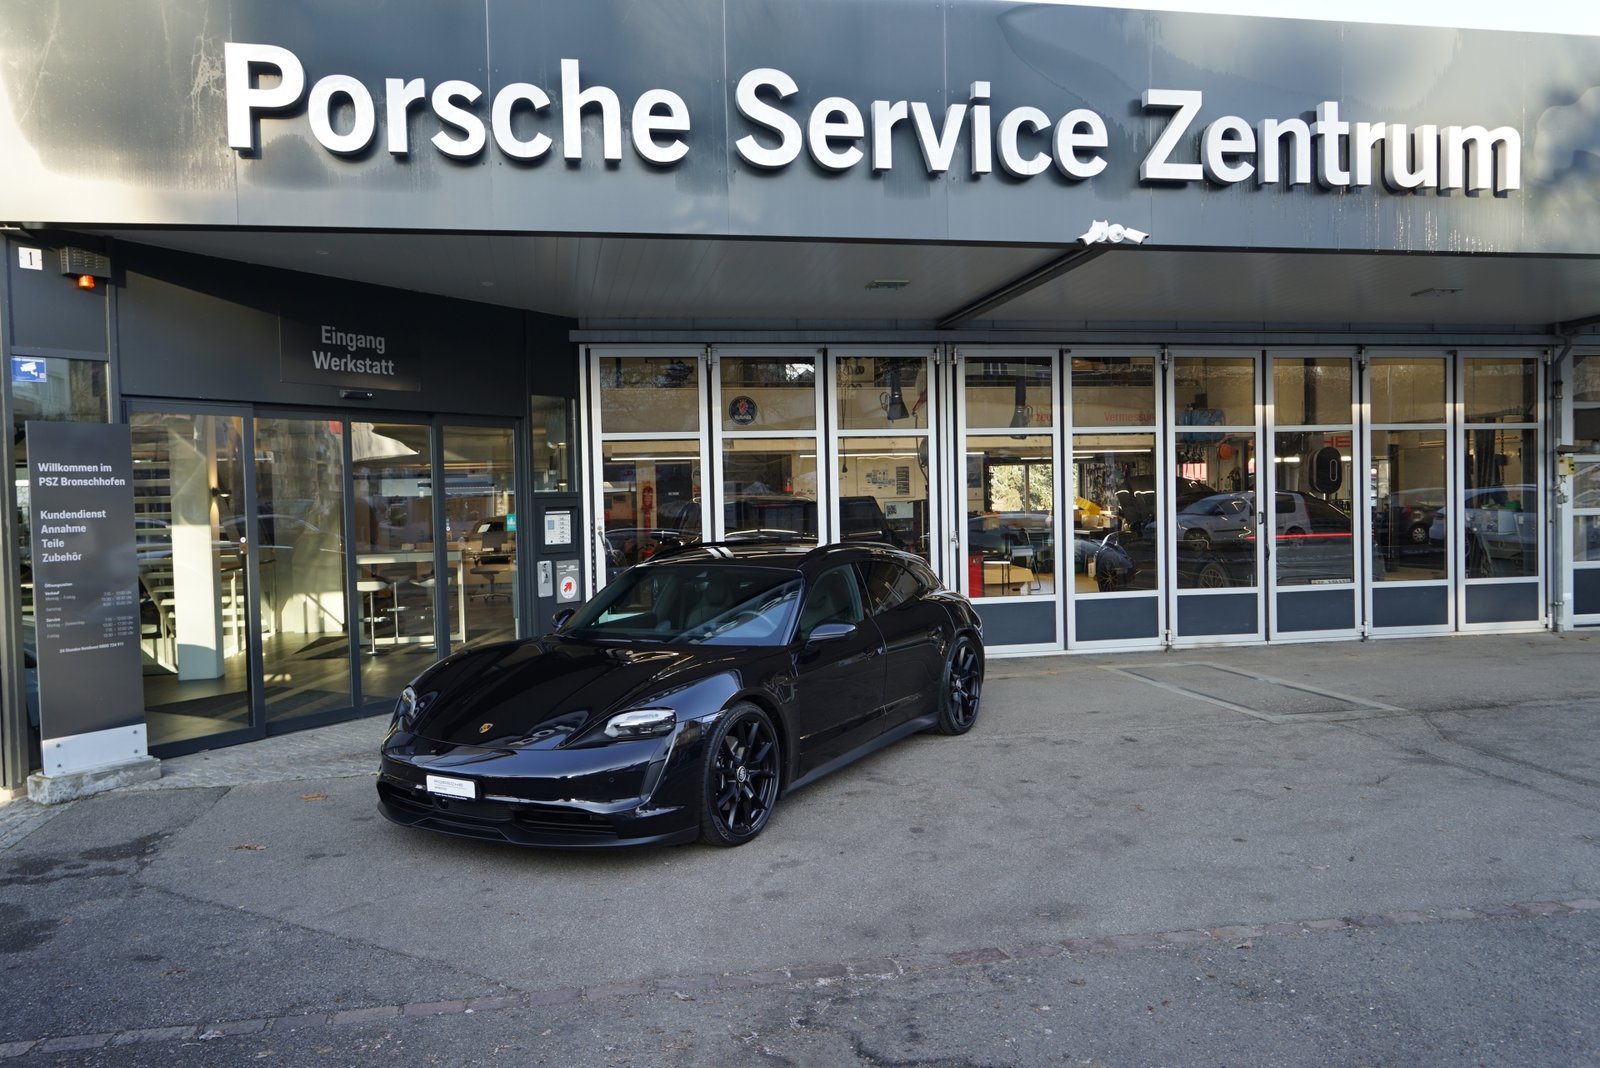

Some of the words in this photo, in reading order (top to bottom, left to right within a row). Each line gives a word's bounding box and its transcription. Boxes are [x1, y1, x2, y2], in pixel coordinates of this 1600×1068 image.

[224, 42, 691, 165] Porsche
[735, 68, 1109, 181] Service
[1139, 88, 1522, 191] Zentrum
[29, 251, 33, 266] 1
[321, 325, 385, 354] Eingang
[312, 350, 395, 375] Werkstatt
[38, 463, 99, 472] Willkommen
[100, 463, 112, 472] im
[39, 477, 59, 486] PSZ
[61, 477, 126, 486] Bronschhofen
[40, 509, 107, 520] Kundendienst
[41, 524, 87, 534] Annahme
[41, 538, 65, 548] Teile
[42, 552, 82, 563] Zubehör
